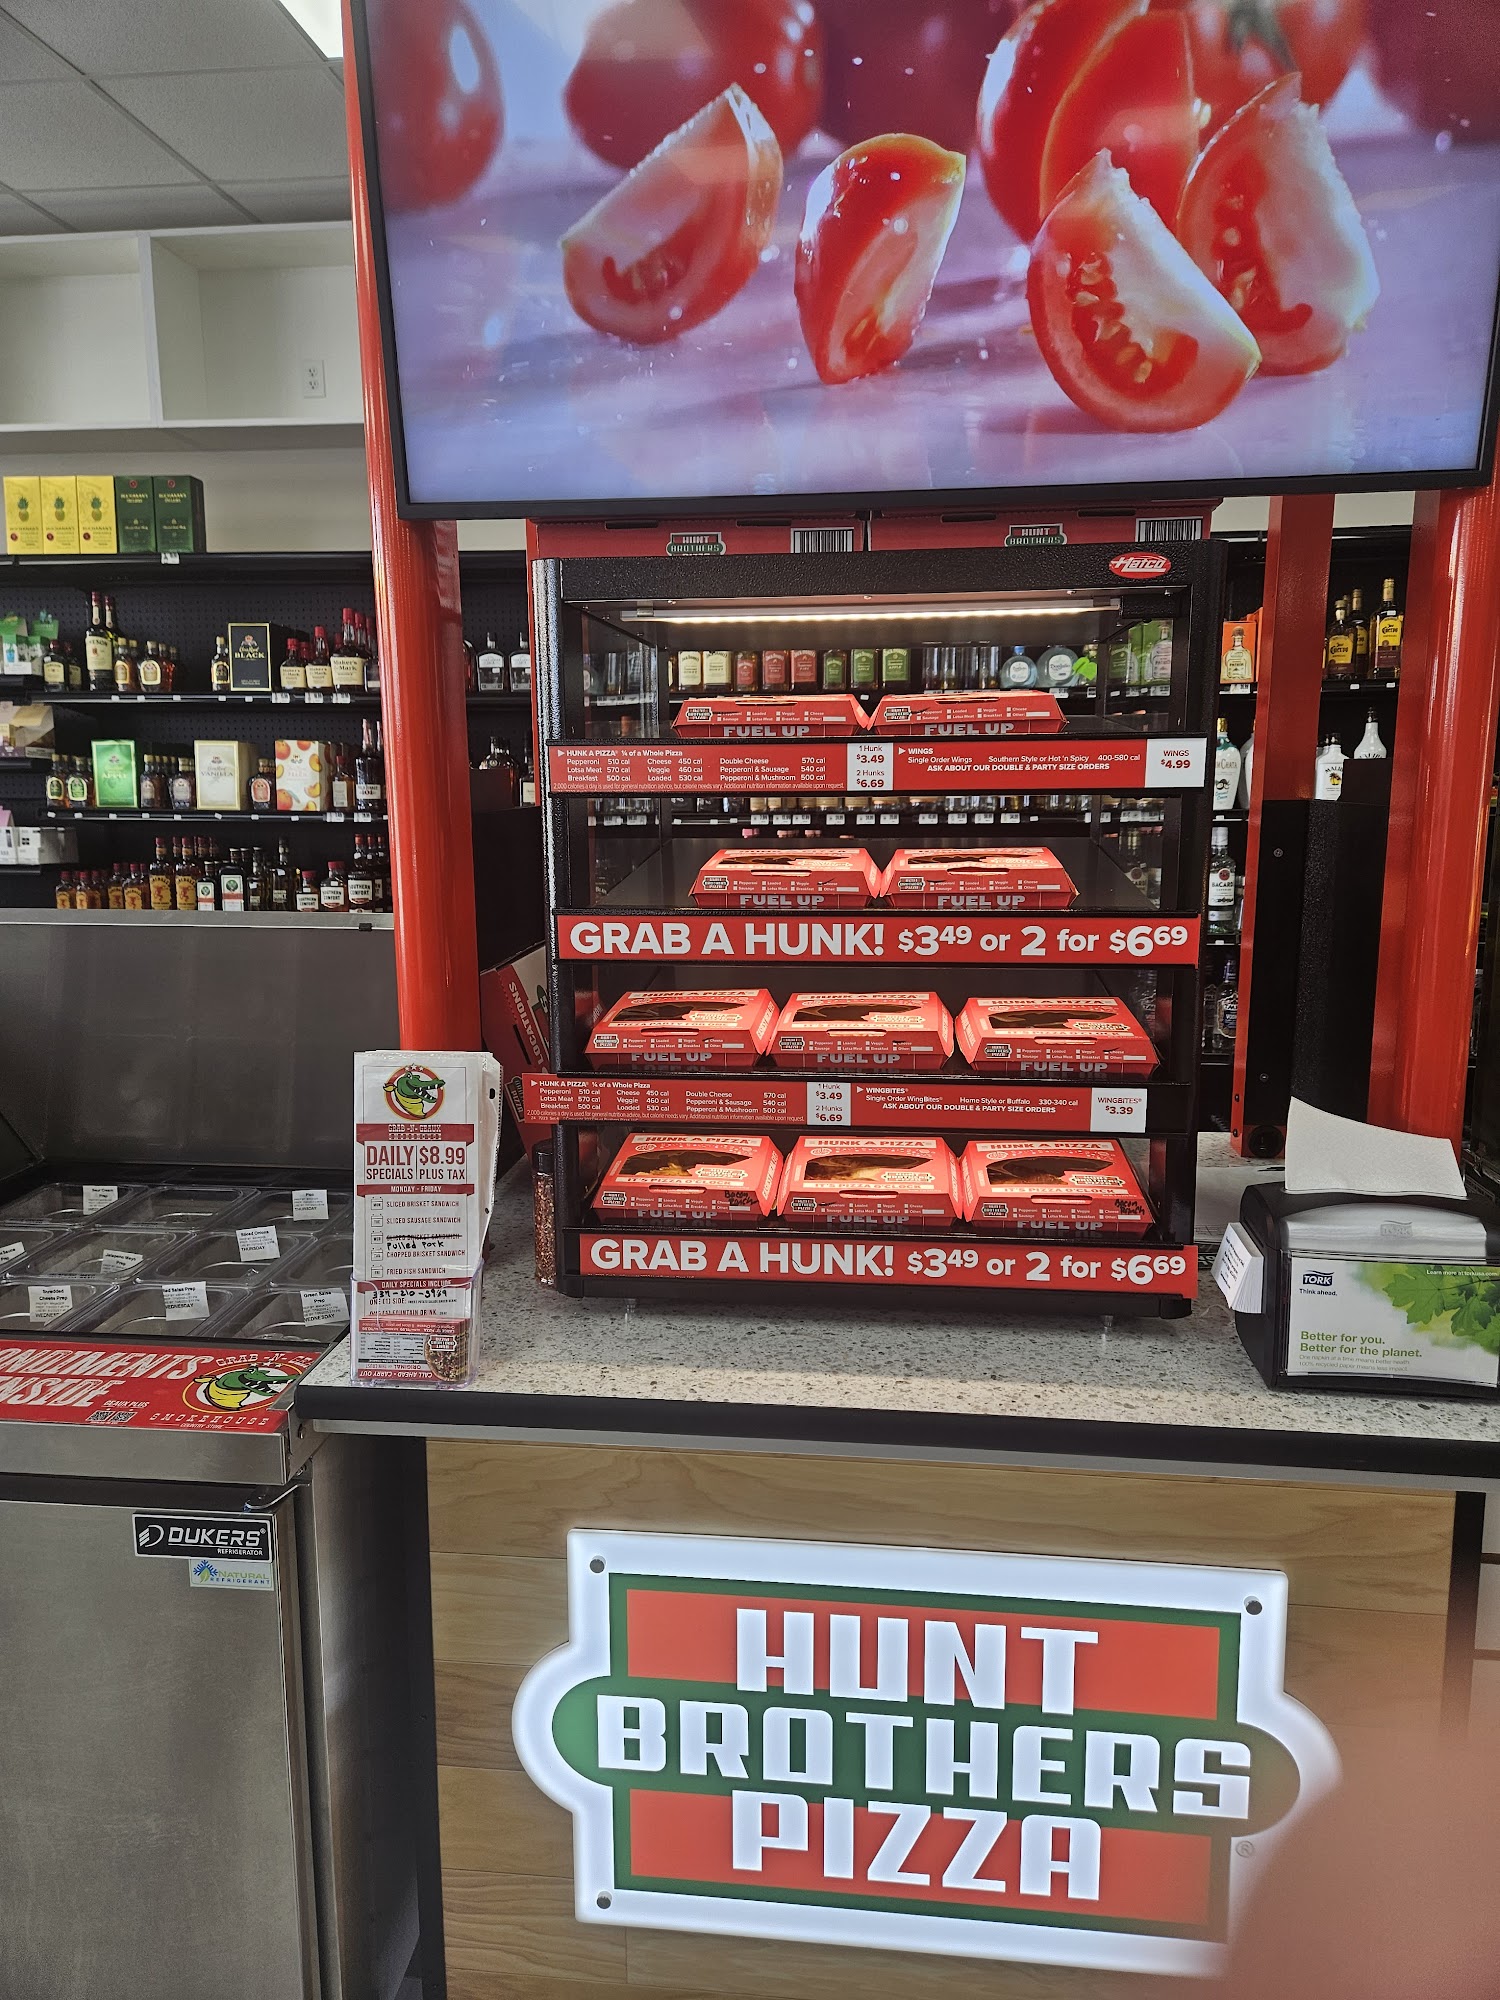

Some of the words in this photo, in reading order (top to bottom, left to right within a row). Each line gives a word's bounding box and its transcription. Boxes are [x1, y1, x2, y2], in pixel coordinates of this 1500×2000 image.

[1022, 527, 1050, 536] HUNT
[682, 535, 709, 544] HUNT
[1010, 536, 1061, 545] BROTHERS
[671, 544, 719, 553] BROTHERS
[1111, 556, 1167, 573] Hatco
[857, 754, 885, 763] $3.49
[908, 756, 929, 764] Single
[951, 756, 972, 764] Wings
[988, 755, 1019, 763] Southern
[1021, 755, 1039, 763] Style
[1070, 755, 1089, 763] Spicy
[1160, 759, 1191, 769] $4.99
[720, 766, 753, 774] Pepperoni
[761, 766, 789, 774] Sausage
[720, 774, 753, 782] Pepperoni
[857, 779, 885, 788] $6.69
[740, 895, 792, 906] FUEL
[797, 895, 825, 906] UP
[570, 921, 691, 955] GRAB
[701, 922, 735, 955] A
[745, 923, 885, 956] HUNK!
[980, 932, 1011, 951] or
[1020, 925, 1046, 956] 2
[1056, 928, 1100, 952] for
[508, 981, 544, 1065] LOCATIONS
[1020, 1061, 1074, 1073] FUEL
[1079, 1061, 1108, 1073] UP
[816, 1091, 843, 1100] $3.49
[1105, 1105, 1134, 1115] $3.39
[816, 1113, 843, 1122] $6.69
[366, 1146, 414, 1166] DAILY
[419, 1146, 466, 1166] $8.99
[366, 1169, 414, 1180] SPECIALS
[419, 1169, 444, 1180] PLUS
[447, 1169, 465, 1180] TAX
[387, 1240, 417, 1251] Pulled
[422, 1240, 445, 1249] Pork
[590, 1238, 707, 1272] GRAB
[717, 1241, 749, 1273] A
[760, 1242, 894, 1277] HUNK!
[986, 1255, 1016, 1276] or
[1026, 1251, 1050, 1281] 2
[1060, 1255, 1101, 1278] for
[382, 1281, 398, 1289] DAILY
[400, 1280, 427, 1288] SPECIALS
[1305, 1275, 1331, 1285] TORK
[1301, 1331, 1336, 1342] Better
[1341, 1333, 1358, 1342] for
[1360, 1336, 1385, 1347] you.
[1300, 1343, 1336, 1354] Better
[1339, 1344, 1357, 1354] for
[1360, 1346, 1379, 1356] the
[1382, 1348, 1422, 1360] planet.
[216, 1353, 259, 1367] GRAB
[217, 1548, 263, 1556] REFRIGERATOR
[219, 1570, 269, 1580] NATURAL
[210, 1577, 270, 1585] REFRIGERANT
[736, 1607, 1099, 1716] HUNT
[597, 1693, 1250, 1820] BROTHERS
[732, 1790, 1102, 1902] PIZZA
